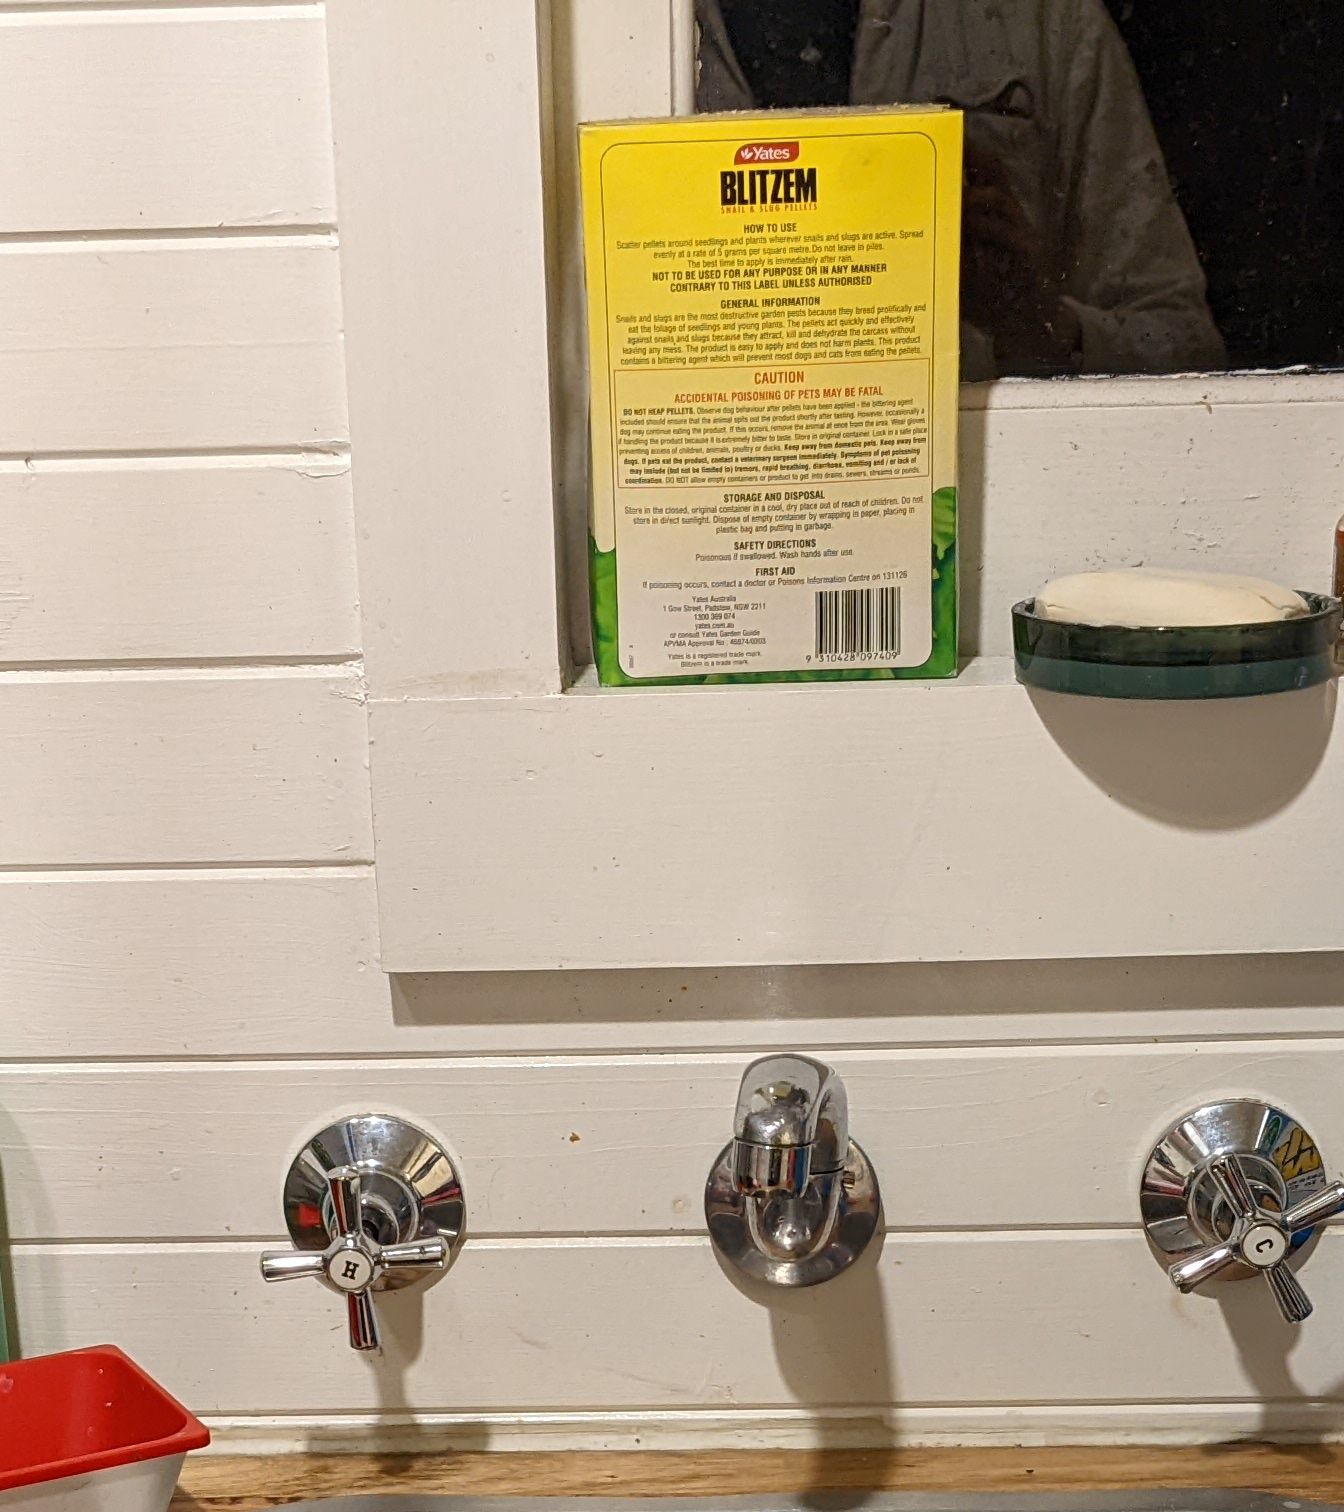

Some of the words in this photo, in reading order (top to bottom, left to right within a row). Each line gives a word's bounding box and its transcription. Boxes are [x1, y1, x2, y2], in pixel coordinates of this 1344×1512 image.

[753, 146, 790, 161] Yates
[720, 168, 817, 206] BLITZEM
[744, 224, 764, 234] HOW
[767, 223, 777, 233] TO
[780, 223, 797, 233] USE
[688, 260, 700, 268] The
[702, 259, 717, 268] best
[720, 258, 735, 267] time
[746, 258, 765, 268] apply
[776, 256, 818, 266] immediately
[820, 255, 836, 264] after
[652, 272, 669, 281] NOT
[672, 271, 682, 280] TO
[686, 270, 696, 280] BE
[699, 270, 720, 280] USED
[724, 269, 740, 279] FOR
[743, 268, 760, 278] ANY
[763, 266, 802, 277] PURPOSE
[806, 266, 817, 276] OR
[820, 266, 828, 274] IN
[831, 265, 848, 274] ANY
[851, 264, 887, 273] MANNER
[670, 282, 715, 292] CONTRARY
[718, 282, 729, 290] TO
[733, 281, 751, 290] THIS
[754, 279, 779, 290] LABEL
[783, 278, 816, 288] UNLESS
[818, 276, 872, 287] AUTHORISED
[720, 300, 758, 309] GENERAL
[762, 296, 820, 307] INFORMATION
[754, 371, 804, 385] CAUTION
[674, 392, 728, 404] ACCIDENTAL
[731, 390, 780, 402] POISONING
[784, 390, 795, 398] OF
[798, 388, 820, 398] PETS
[822, 388, 842, 398] MAY
[845, 388, 855, 397] BE
[858, 386, 883, 396] FATAL
[724, 492, 762, 503] STORAGE
[764, 492, 782, 501] AND
[784, 490, 825, 500] DISPOSAL
[716, 526, 738, 534] plastic
[740, 526, 752, 534] bag
[754, 524, 768, 532] and
[770, 524, 794, 532] putting
[734, 542, 764, 550] SAFETY
[767, 539, 816, 549] DIRECTIONS
[696, 554, 731, 562] Poisonous
[780, 551, 798, 559] Wash
[800, 550, 821, 558] hands
[756, 568, 778, 576] FIRST
[781, 567, 796, 575] AID
[711, 580, 736, 588] contact
[744, 579, 766, 587] doctor
[778, 578, 804, 586] Poisons
[806, 576, 846, 584] Information
[848, 574, 870, 582] Centre
[806, 655, 812, 664] 9
[819, 653, 856, 662] 310428
[860, 652, 898, 661] 097409
[1256, 1238, 1274, 1254] C
[341, 1260, 360, 1280] H
